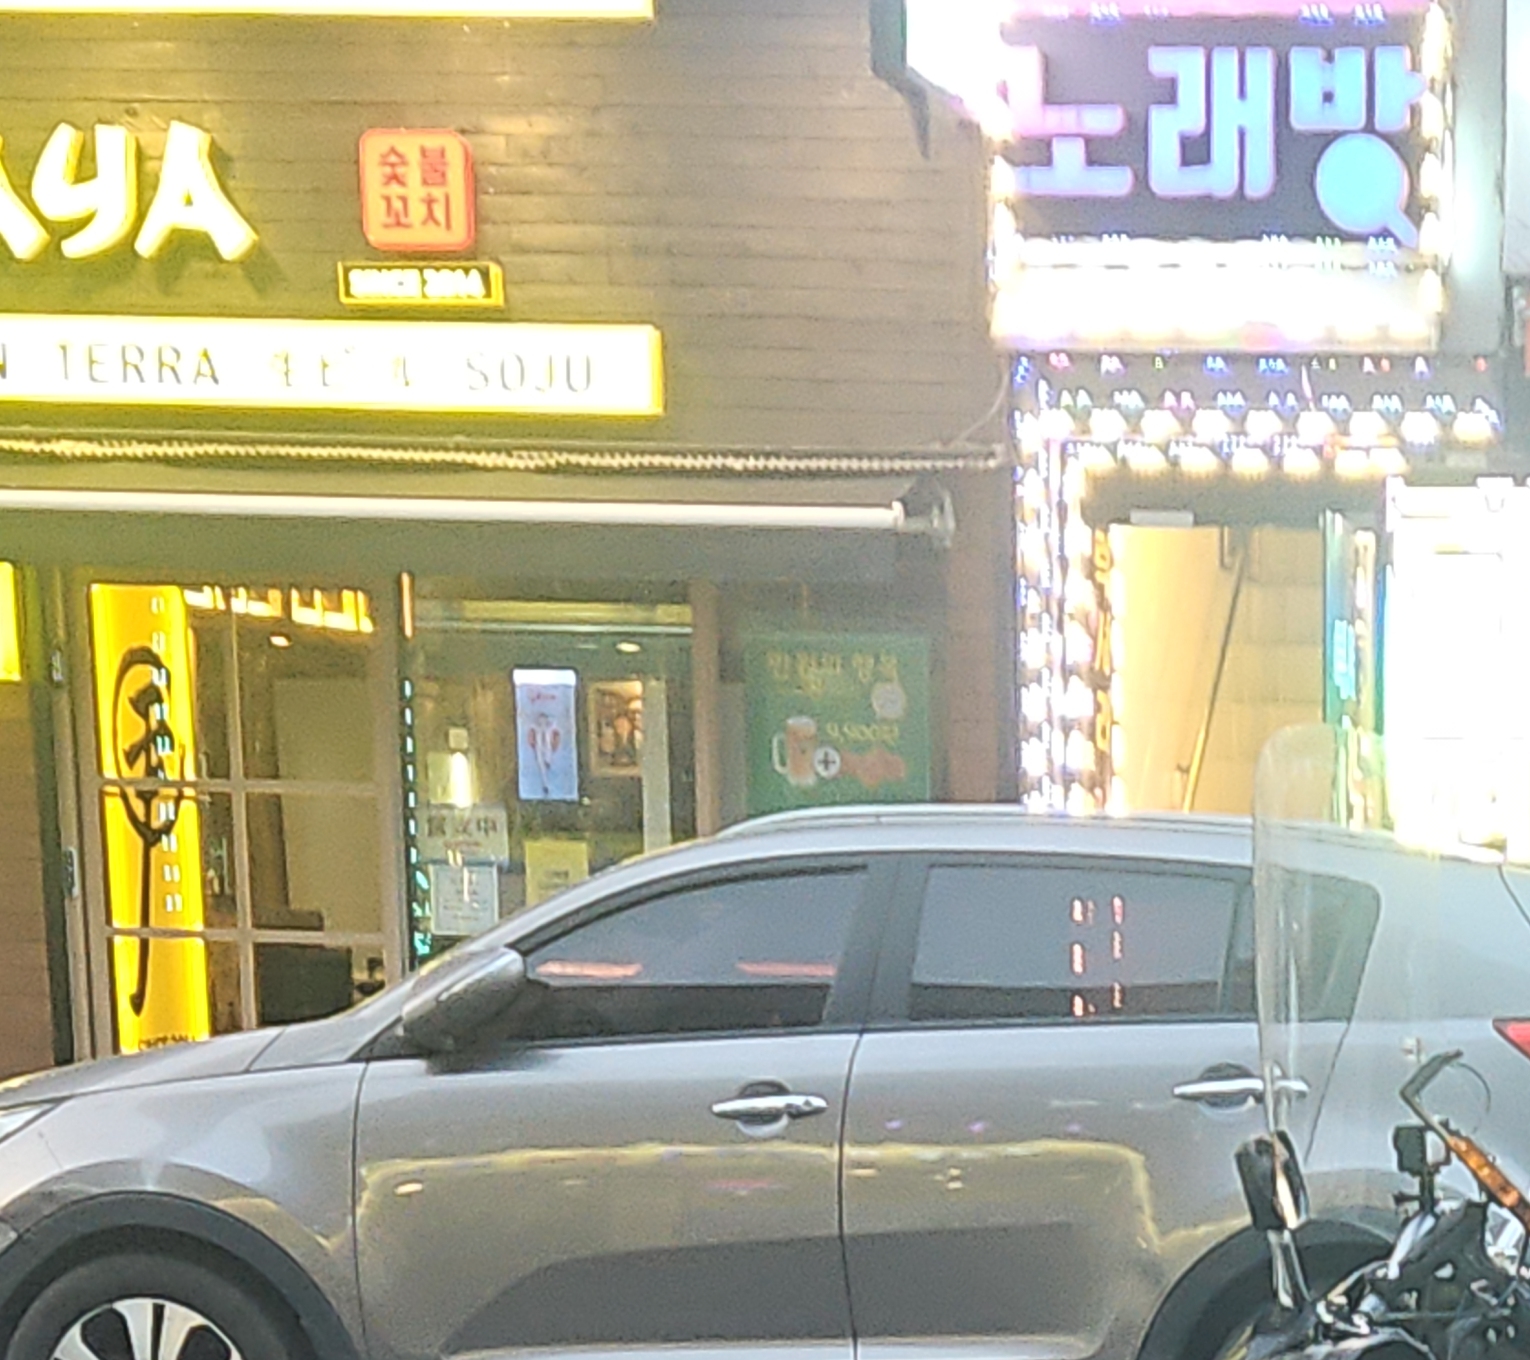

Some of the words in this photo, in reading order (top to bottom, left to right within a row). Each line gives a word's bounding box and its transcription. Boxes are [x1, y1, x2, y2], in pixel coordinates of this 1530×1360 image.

[377, 145, 450, 187] 숯불
[1000, 45, 1430, 248] 노래방
[379, 191, 454, 232] 꼬치
[468, 352, 595, 394] SOJU
